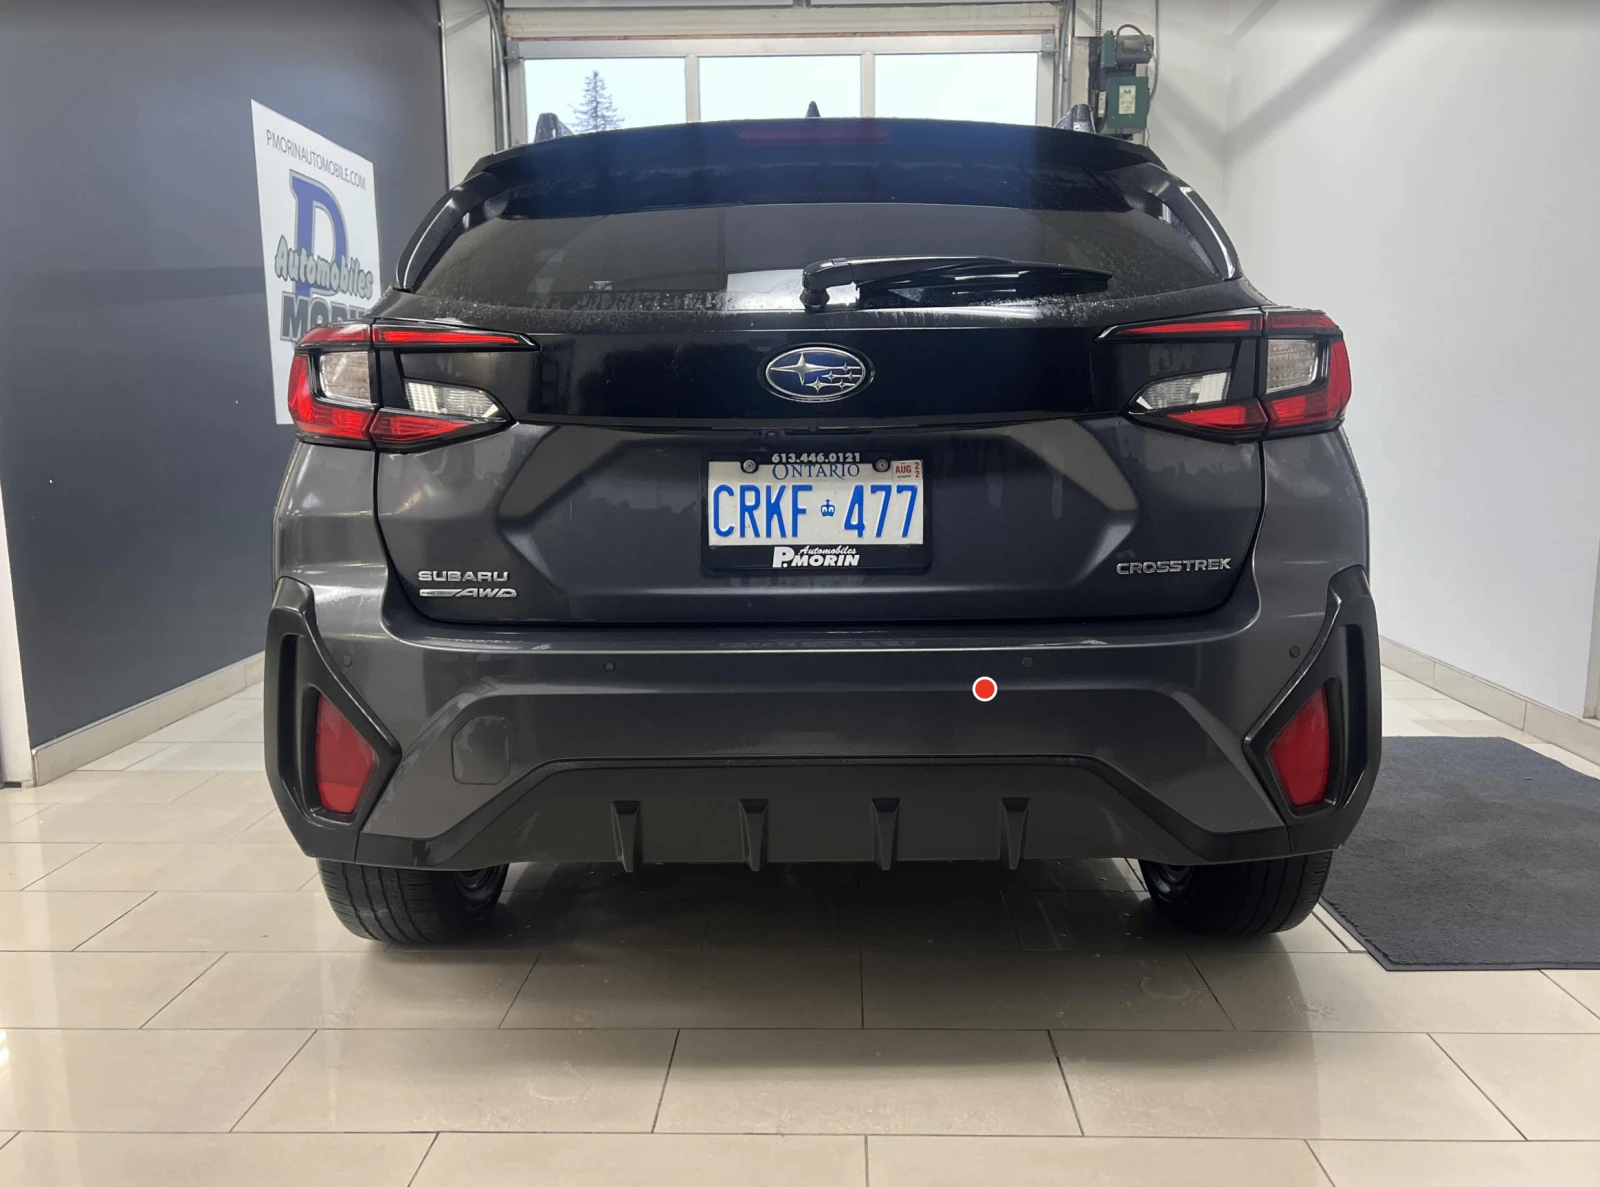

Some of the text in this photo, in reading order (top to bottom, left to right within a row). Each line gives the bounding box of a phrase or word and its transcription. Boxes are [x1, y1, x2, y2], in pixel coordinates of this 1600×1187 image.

[266, 129, 367, 191] PMORINAUTOMOBILE.COM
[275, 235, 374, 300] Automobiles
[771, 452, 860, 463] 613.446.0121
[772, 463, 860, 480] ONTARIO
[895, 465, 912, 474] AUG
[713, 484, 918, 538] CRKF 477
[798, 545, 857, 555] Automobiles
[1116, 558, 1231, 575] CROSSTREK
[418, 571, 509, 582] SUBARU
[455, 588, 518, 598] AWD
